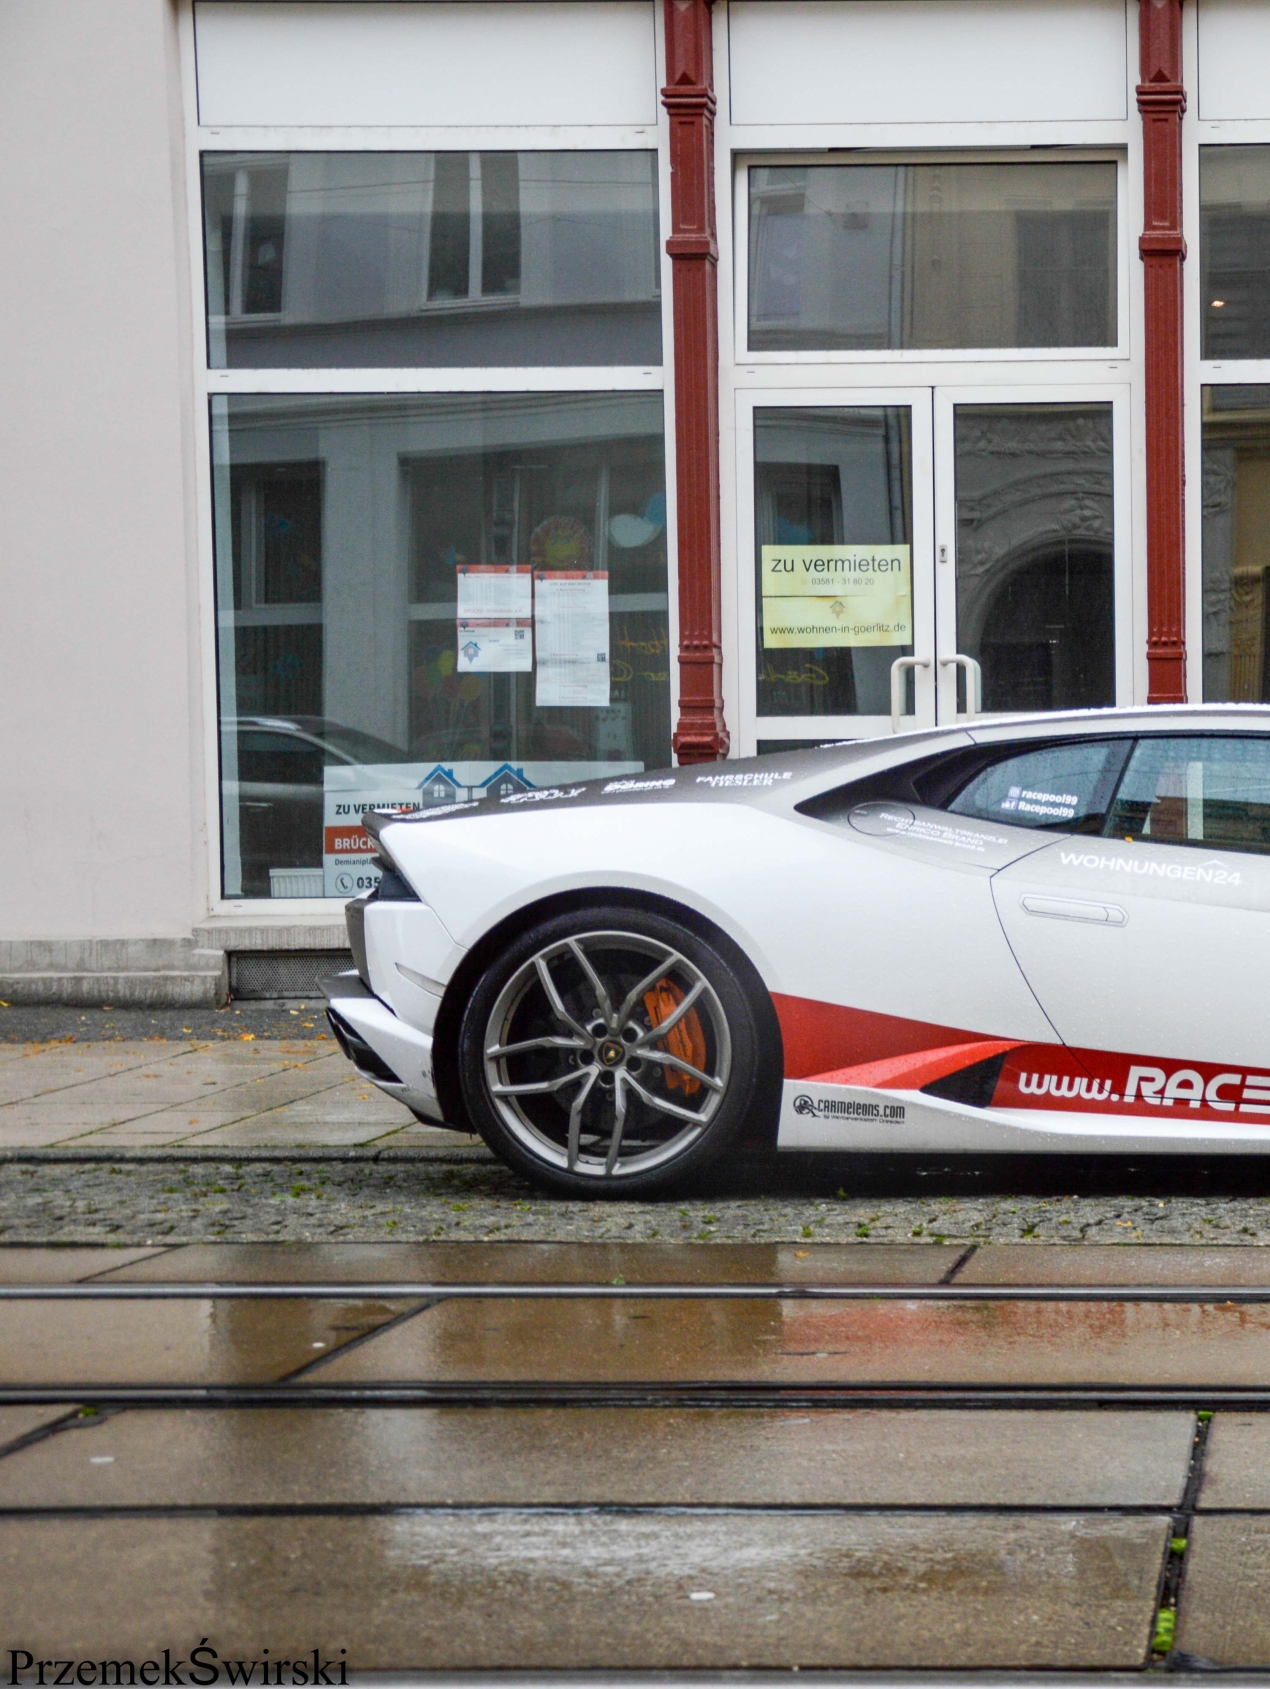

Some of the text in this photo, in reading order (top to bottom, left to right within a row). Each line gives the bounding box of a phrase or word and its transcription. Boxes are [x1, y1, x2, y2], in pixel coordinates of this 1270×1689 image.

[770, 554, 901, 573] zu vermieten
[811, 578, 835, 586] 03581
[841, 578, 851, 586] 31
[853, 578, 863, 586] 80
[864, 578, 875, 586] 20
[769, 622, 907, 635] www.wohnen-in-goerlitz.de
[696, 772, 792, 784] FAHRSCHULE
[1022, 790, 1078, 806] racepool99
[335, 804, 350, 815] ZU
[1018, 801, 1075, 818] Racepool99
[334, 836, 375, 849] BRÜCK
[335, 858, 372, 866] Demianipla
[1059, 850, 1242, 886] WOHNUNGEN24
[356, 877, 380, 889] 035
